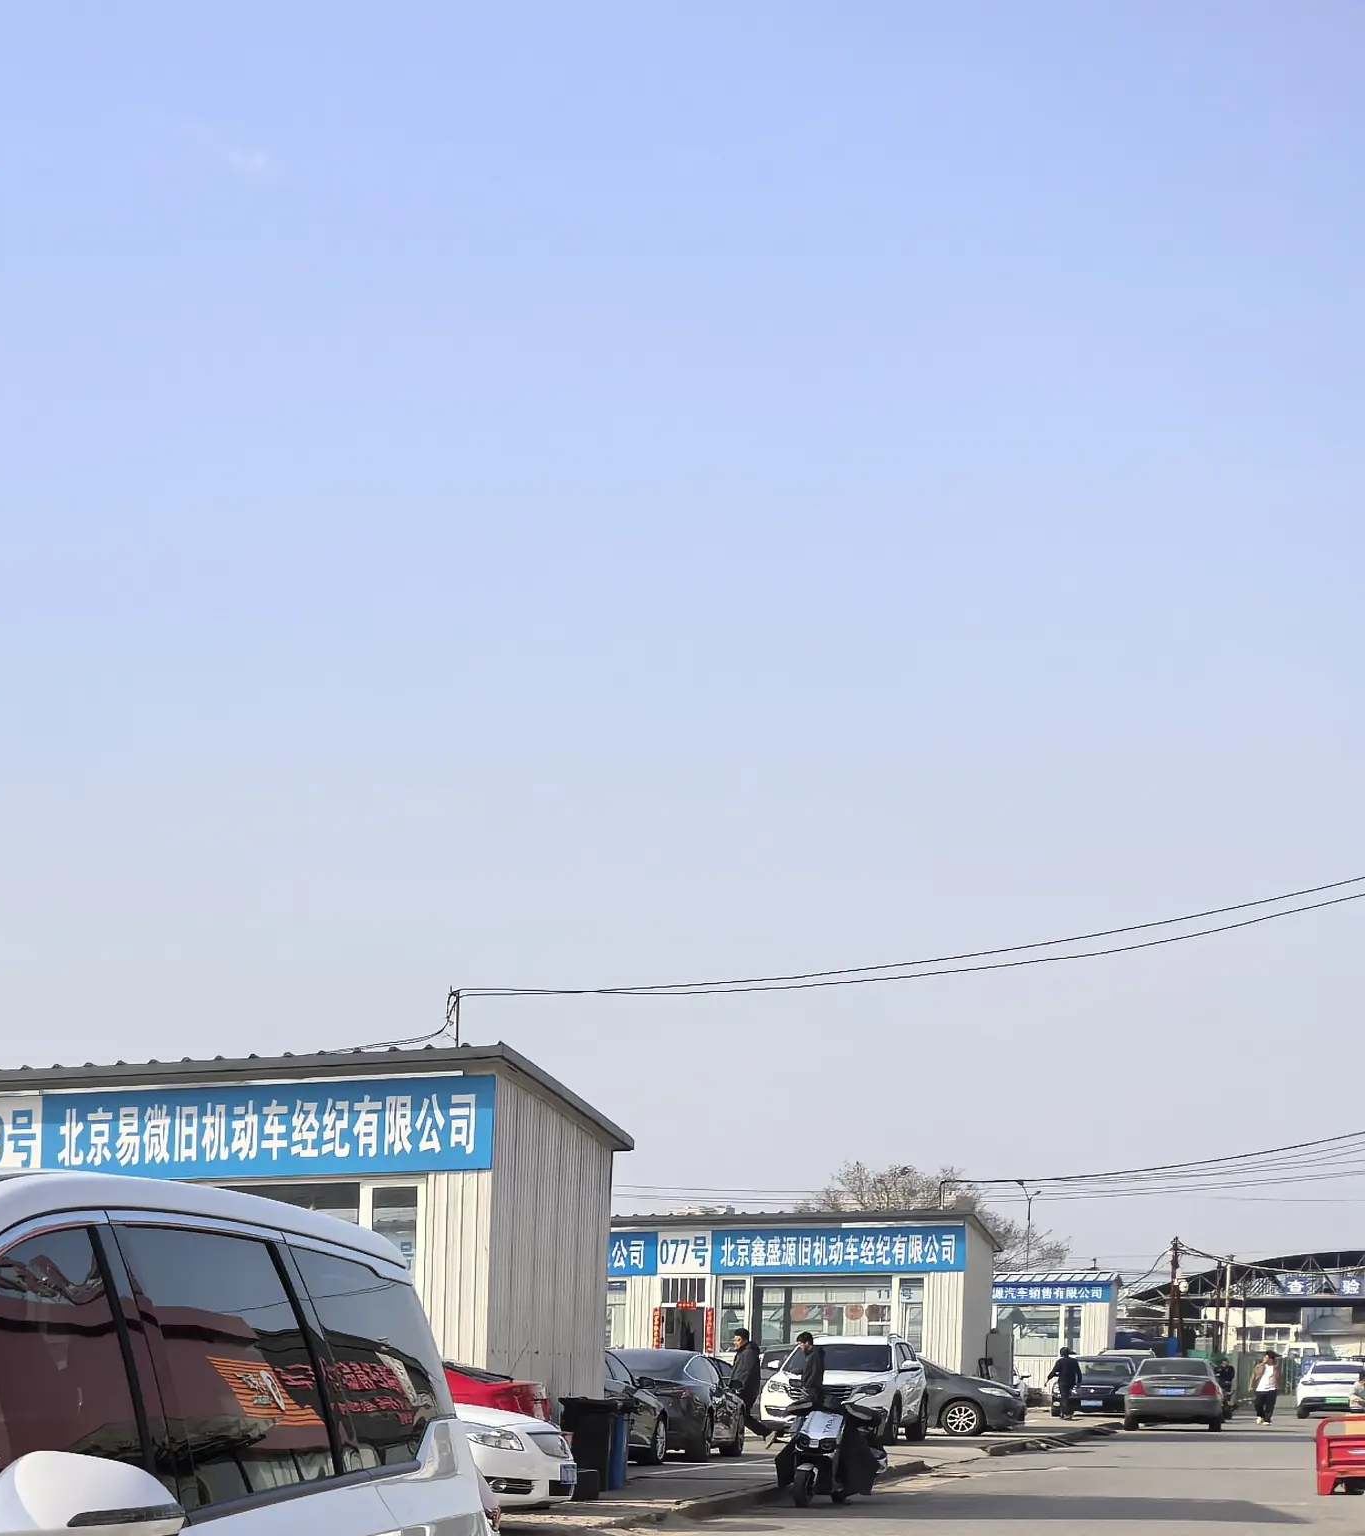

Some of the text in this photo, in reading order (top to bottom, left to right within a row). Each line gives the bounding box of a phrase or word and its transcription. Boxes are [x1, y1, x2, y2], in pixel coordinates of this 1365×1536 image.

[57, 1093, 477, 1168] 北京易微旧机动车经纪有限公司
[608, 1239, 645, 1269] 公司
[660, 1235, 709, 1267] 077号
[719, 1233, 956, 1268] 北京鑫盛源旧机动车经纪有限公司
